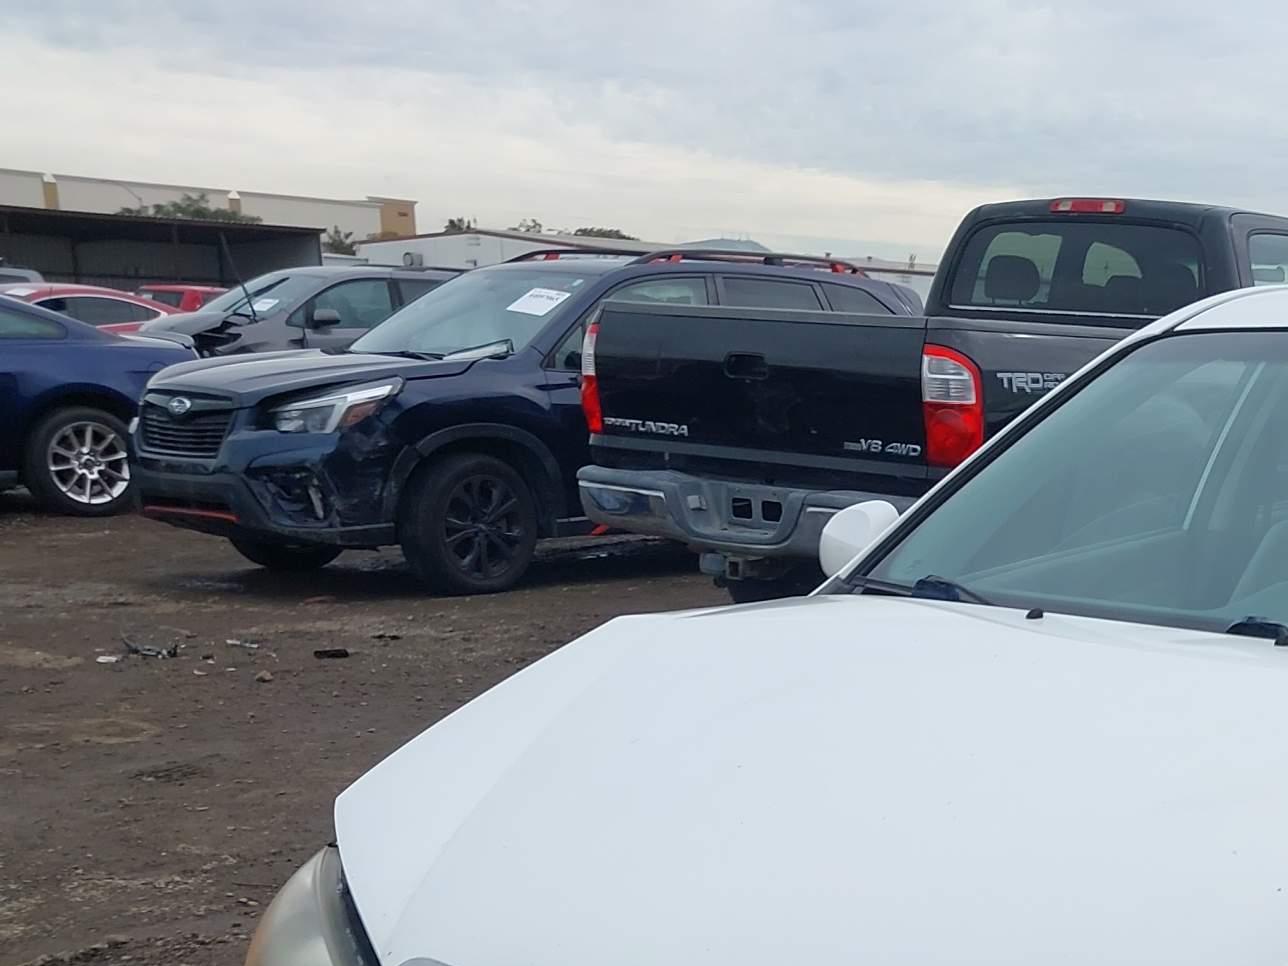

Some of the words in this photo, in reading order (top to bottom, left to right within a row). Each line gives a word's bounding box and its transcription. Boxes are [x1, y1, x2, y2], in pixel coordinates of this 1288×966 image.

[996, 372, 1043, 393] TRD
[628, 419, 689, 437] TUNDRA
[860, 438, 882, 453] V8
[885, 442, 922, 456] 4WD
